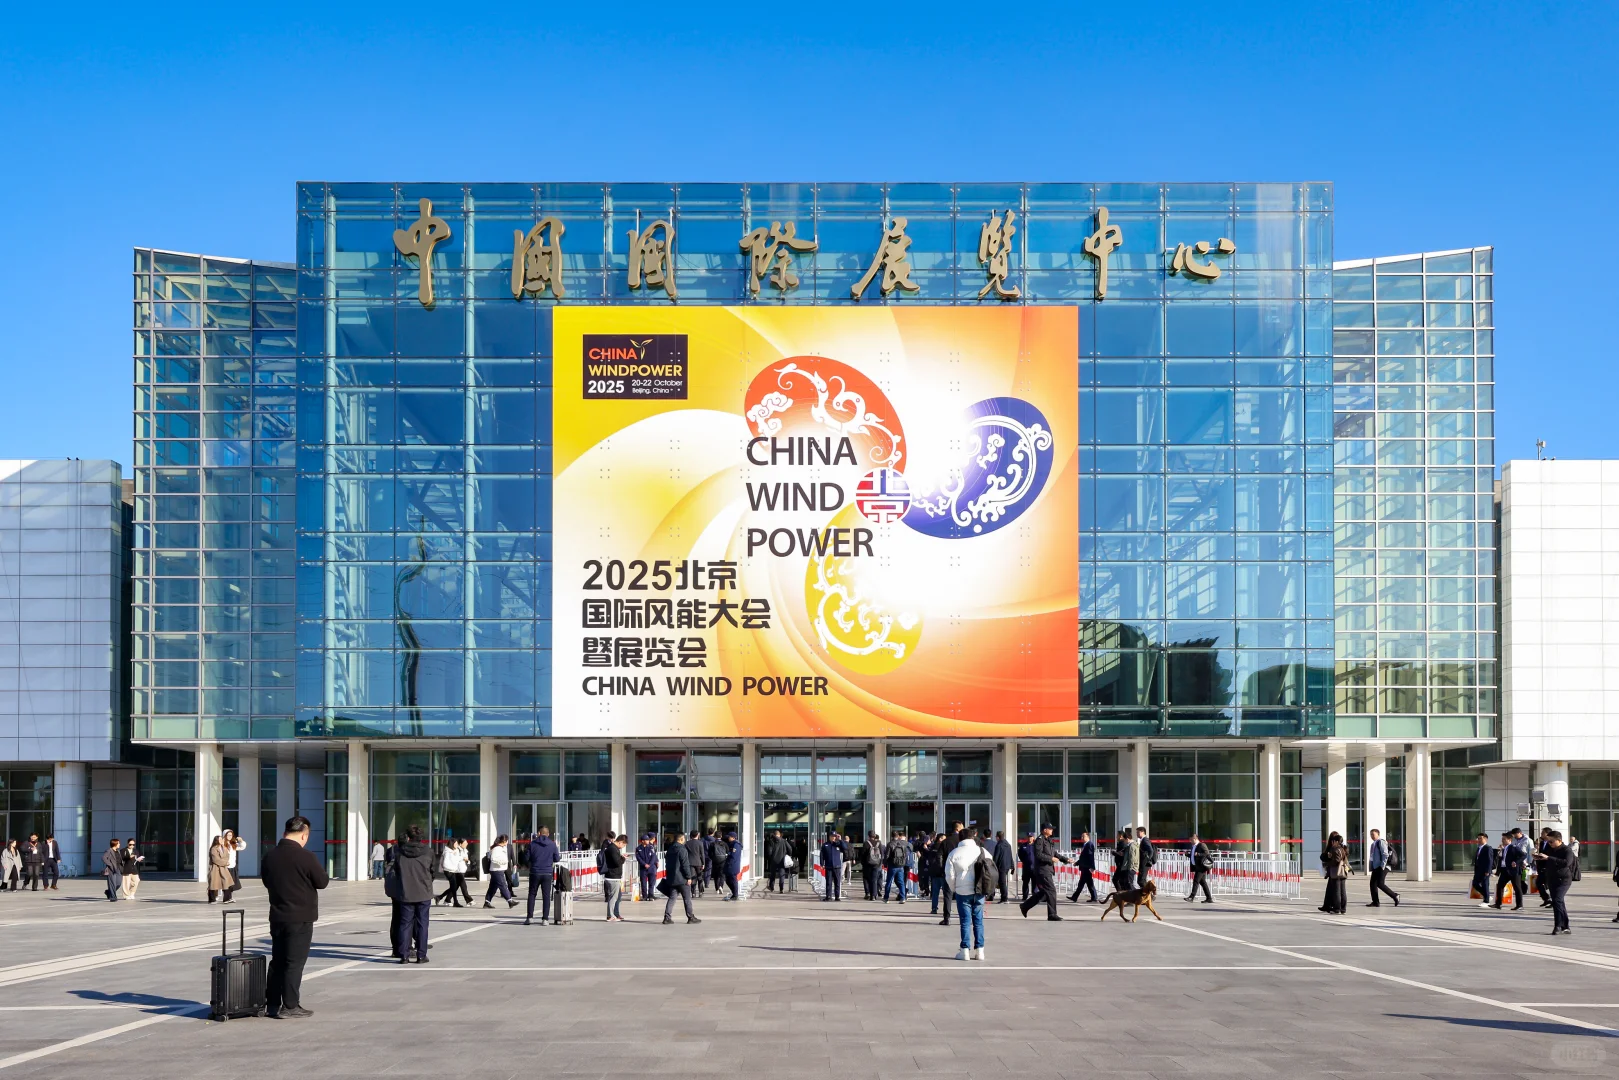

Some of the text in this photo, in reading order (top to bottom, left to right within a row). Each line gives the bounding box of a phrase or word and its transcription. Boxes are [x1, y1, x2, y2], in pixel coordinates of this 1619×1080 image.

[588, 347, 638, 360] CHINA
[588, 364, 683, 377] WINDPOWER
[631, 379, 683, 387] 20-22 October
[587, 380, 625, 394] 2025
[746, 436, 858, 466] CHINA
[746, 482, 845, 511] WIND
[747, 527, 874, 557] POWER
[582, 559, 738, 591] 2025北京
[582, 598, 771, 629] 国际风能大会
[582, 637, 707, 668] 暨展览会
[582, 676, 829, 696] CHINA WIND POWER
